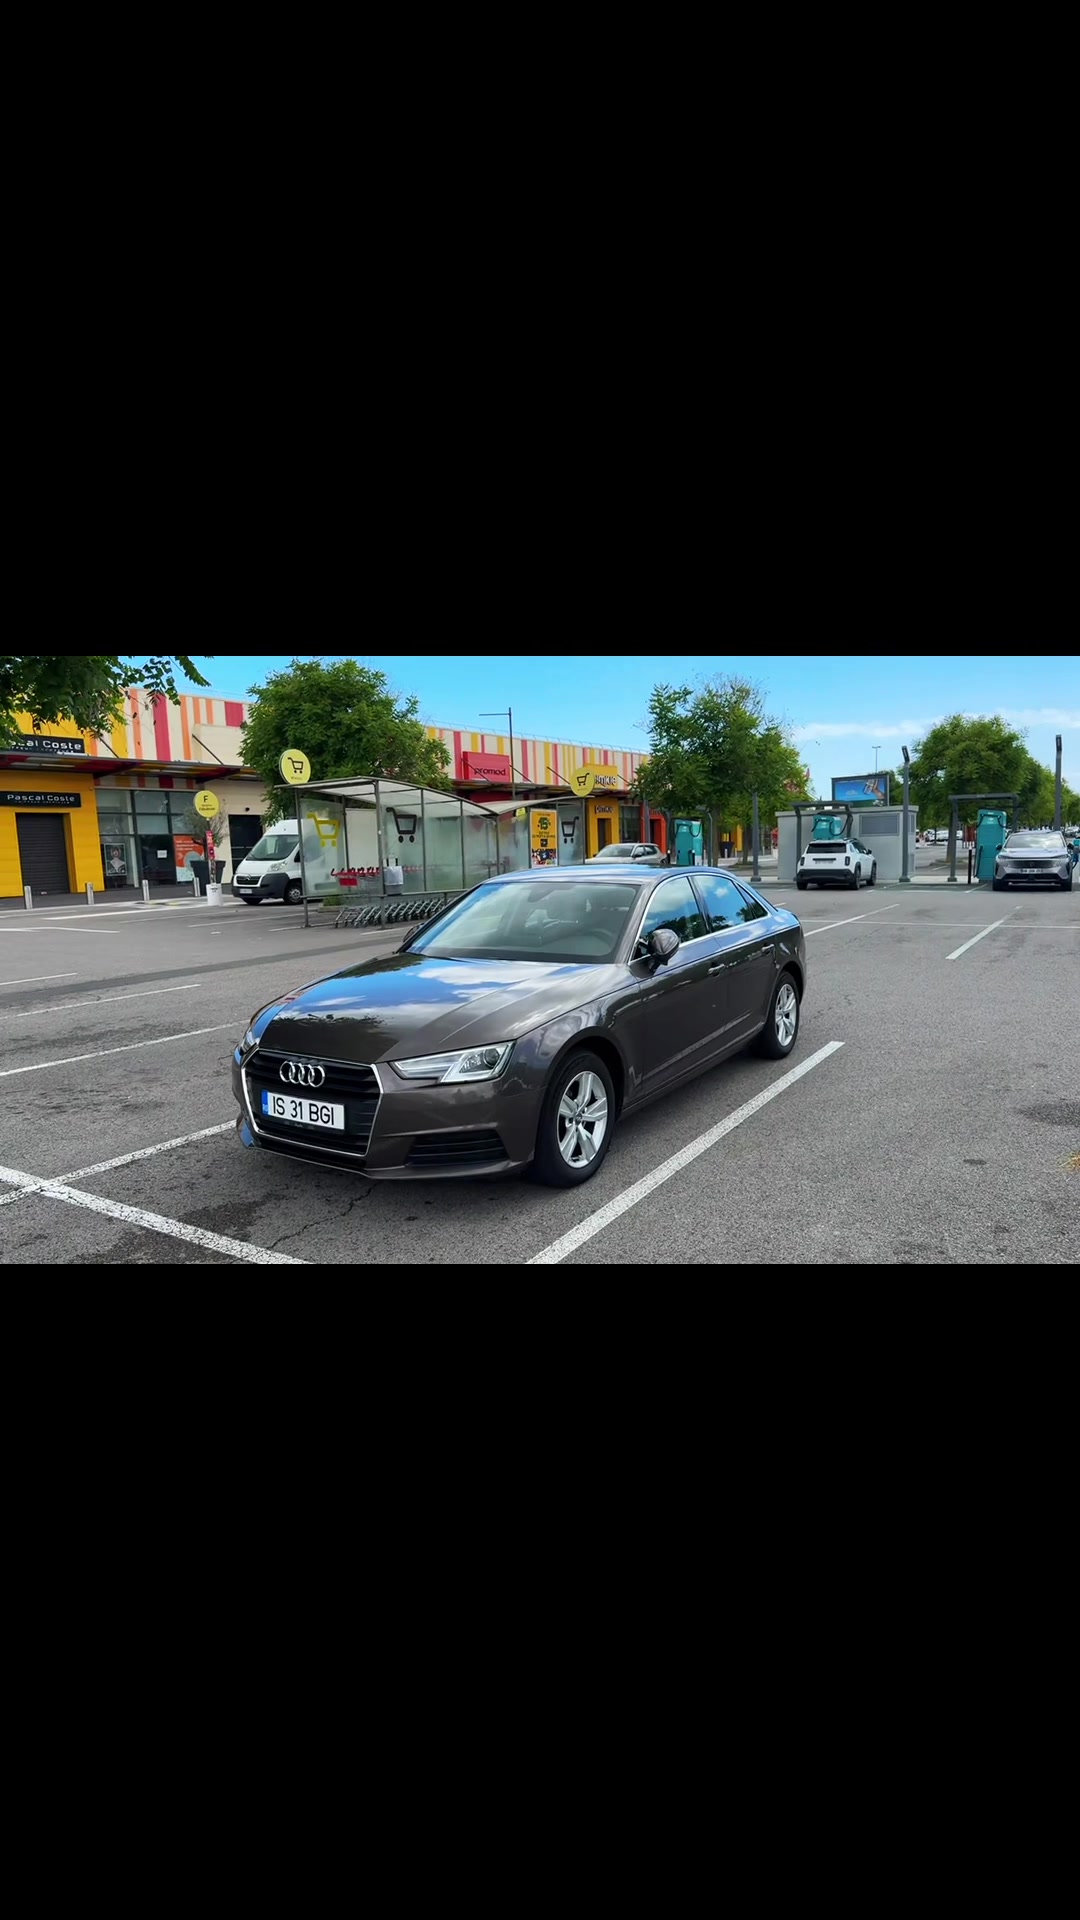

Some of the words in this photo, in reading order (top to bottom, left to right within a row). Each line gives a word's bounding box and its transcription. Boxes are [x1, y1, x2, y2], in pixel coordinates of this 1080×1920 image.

[42, 740, 82, 750] Coste
[474, 767, 506, 776] promod
[203, 795, 209, 803] F
[272, 1095, 286, 1116] IS
[290, 1099, 303, 1120] 31
[308, 1102, 335, 1126] BGI
